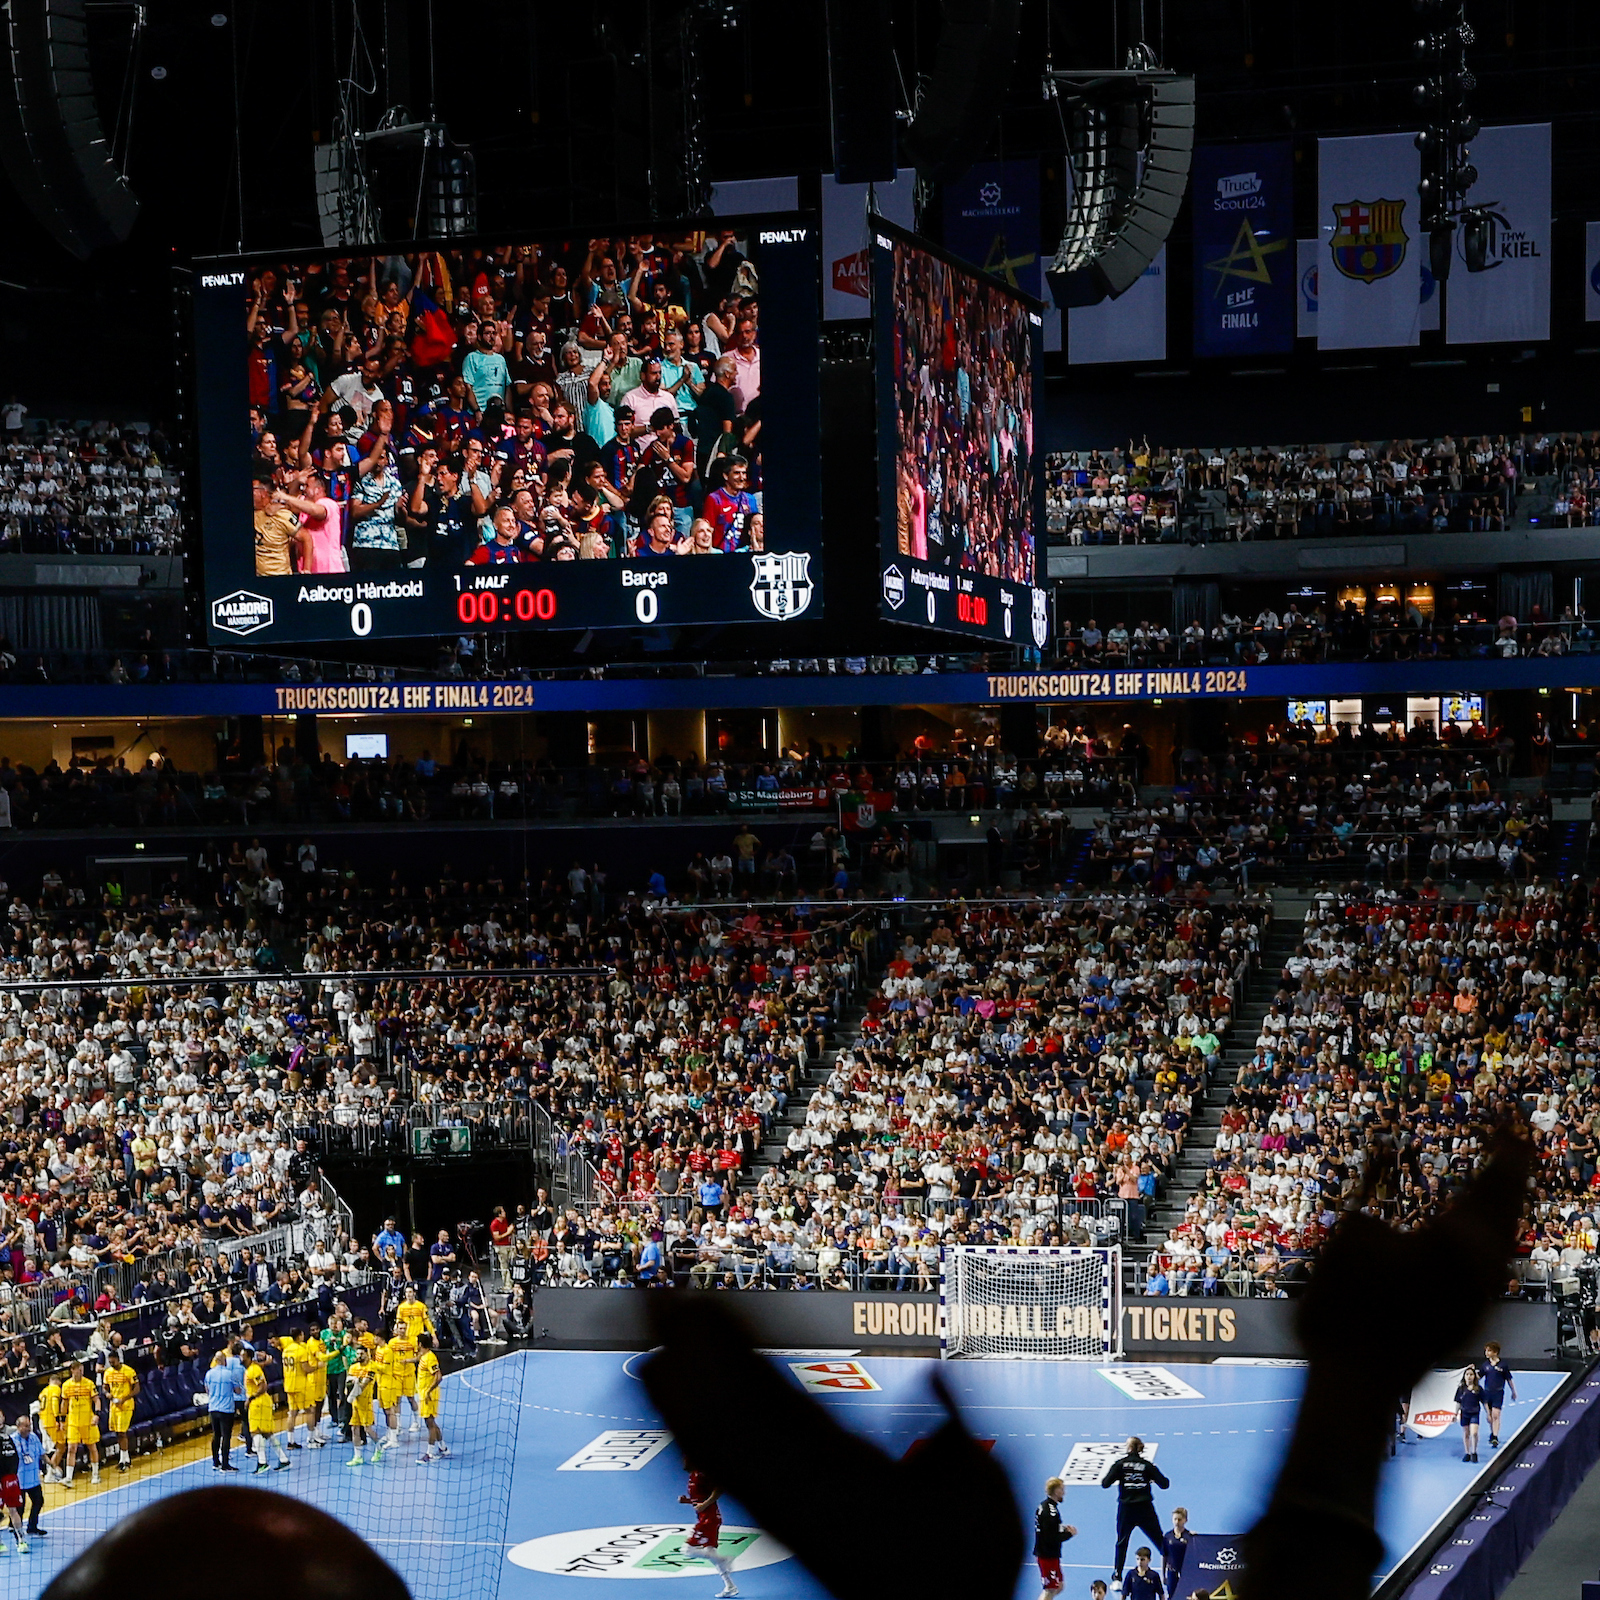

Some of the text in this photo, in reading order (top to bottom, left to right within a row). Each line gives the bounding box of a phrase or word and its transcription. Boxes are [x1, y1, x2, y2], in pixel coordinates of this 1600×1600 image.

[1222, 177, 1257, 193] Truck
[1213, 195, 1267, 212] Scout24
[759, 229, 807, 245] PENALTY
[1500, 231, 1526, 242] THW
[1500, 242, 1541, 259] KIEL
[201, 272, 245, 289] PENALTY
[1226, 287, 1256, 305] EHF
[1221, 312, 1259, 329] FINAL4
[622, 569, 668, 589] Barça
[298, 577, 424, 605] Aalborg Håndbold
[214, 597, 271, 618] AALBORG
[458, 588, 557, 624] 00:00
[635, 589, 659, 624] 0
[351, 602, 373, 637] 0
[987, 670, 1247, 698] TRUCKSCOUT24 EHF FINAL4 2024
[275, 685, 534, 710] TRUCKSCOUT24 EHF FINAL4 2024
[574, 1431, 668, 1469] HEITEC
[554, 1525, 687, 1573] Scout24
